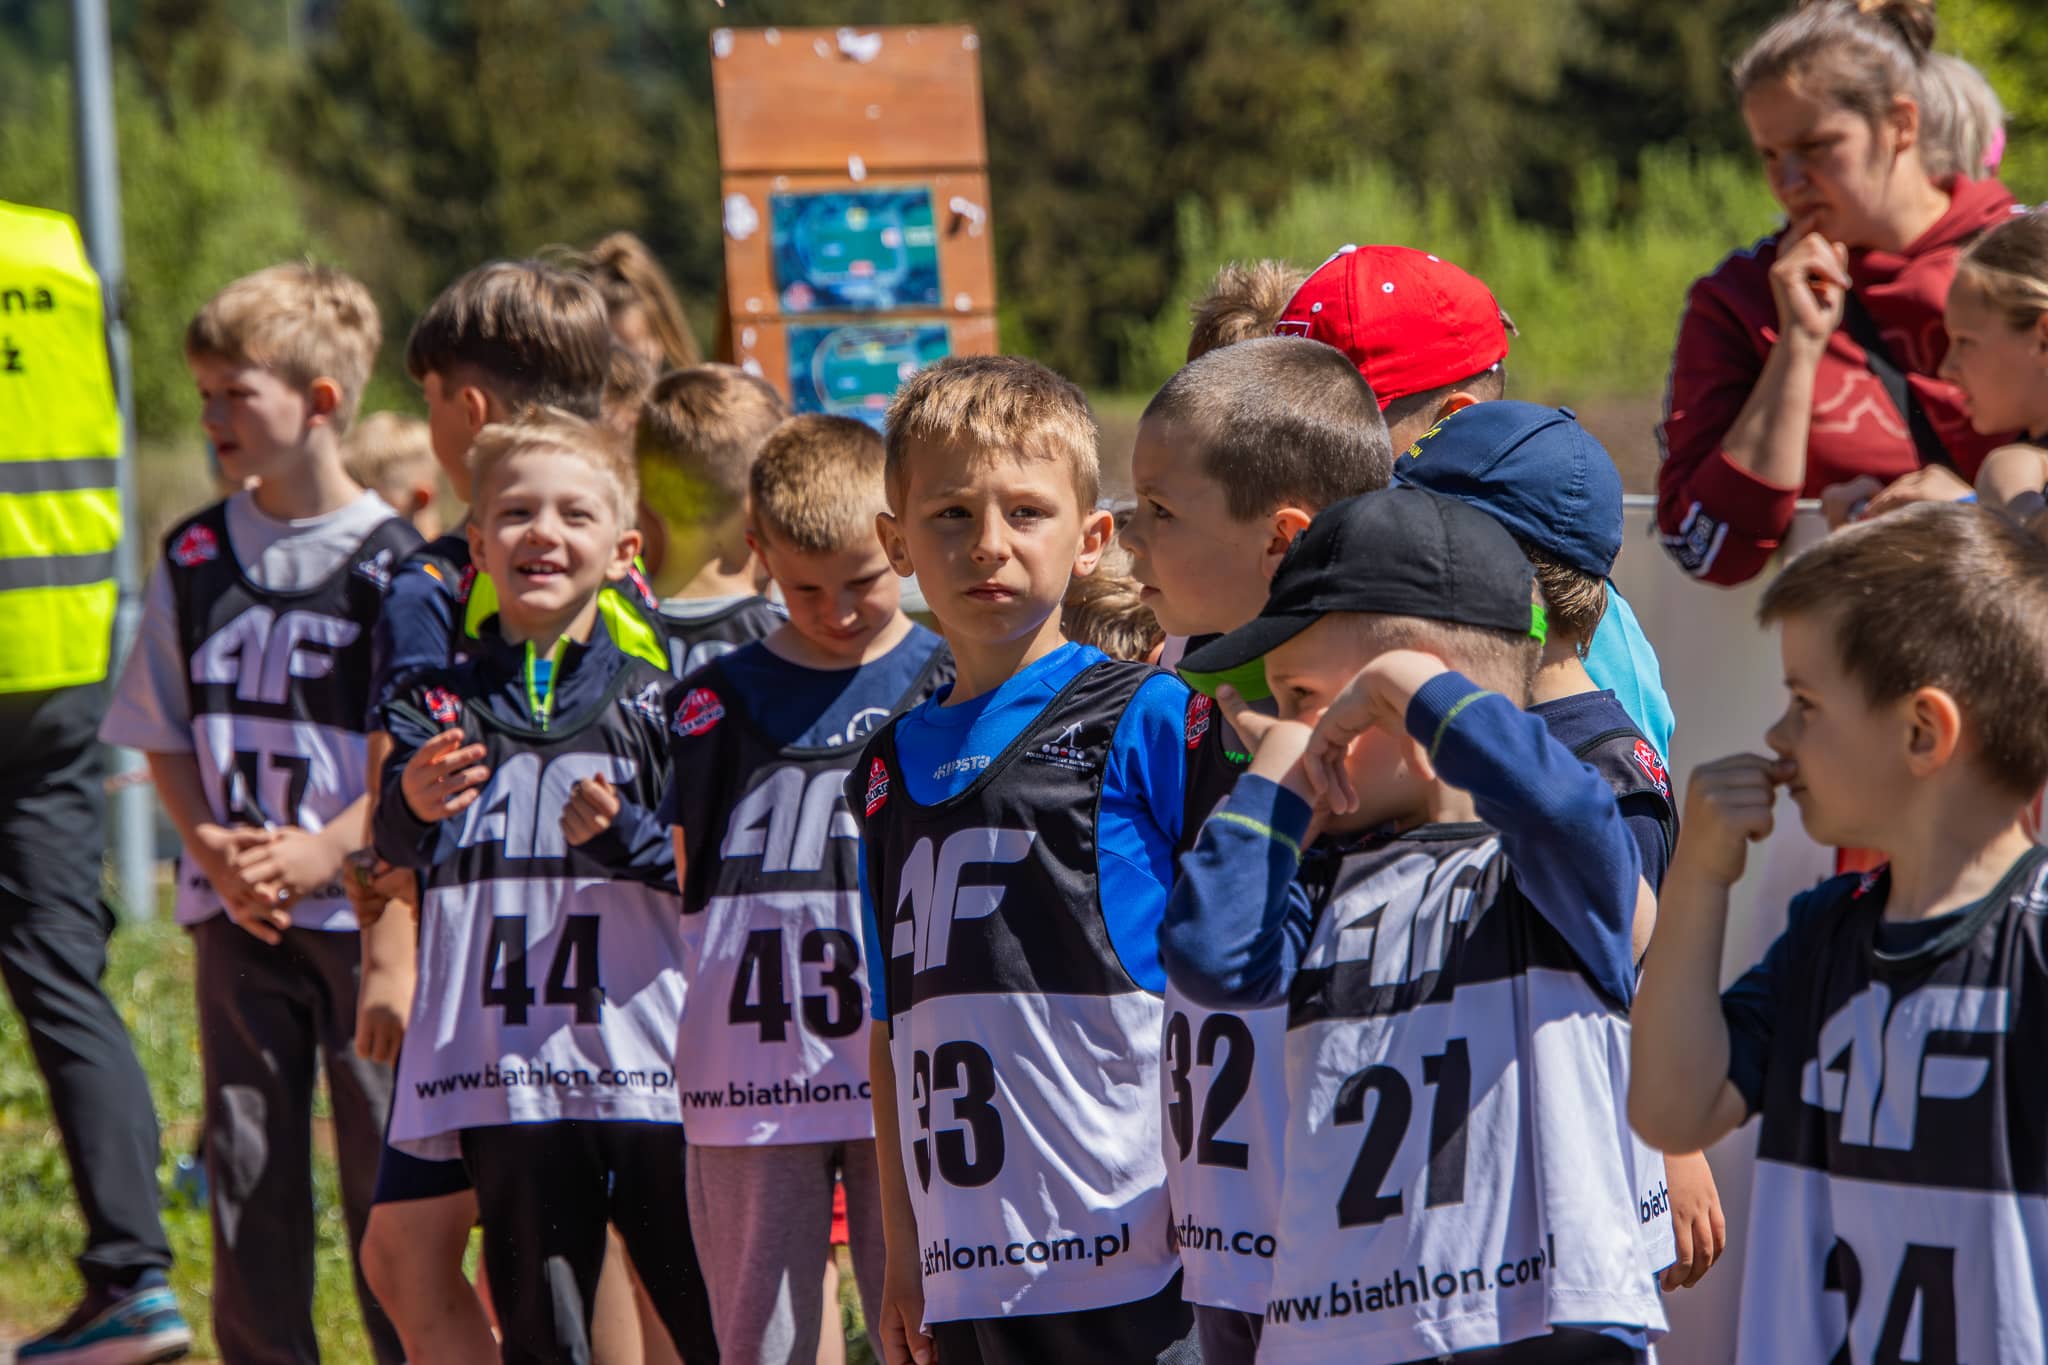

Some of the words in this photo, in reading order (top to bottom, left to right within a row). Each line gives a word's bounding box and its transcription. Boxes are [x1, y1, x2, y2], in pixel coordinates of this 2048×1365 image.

[481, 915, 607, 1026] 44
[728, 928, 865, 1043] 43
[1165, 1011, 1255, 1171] 32
[1333, 1038, 1472, 1229] 21
[921, 1222, 1131, 1276] athlon.com.pl
